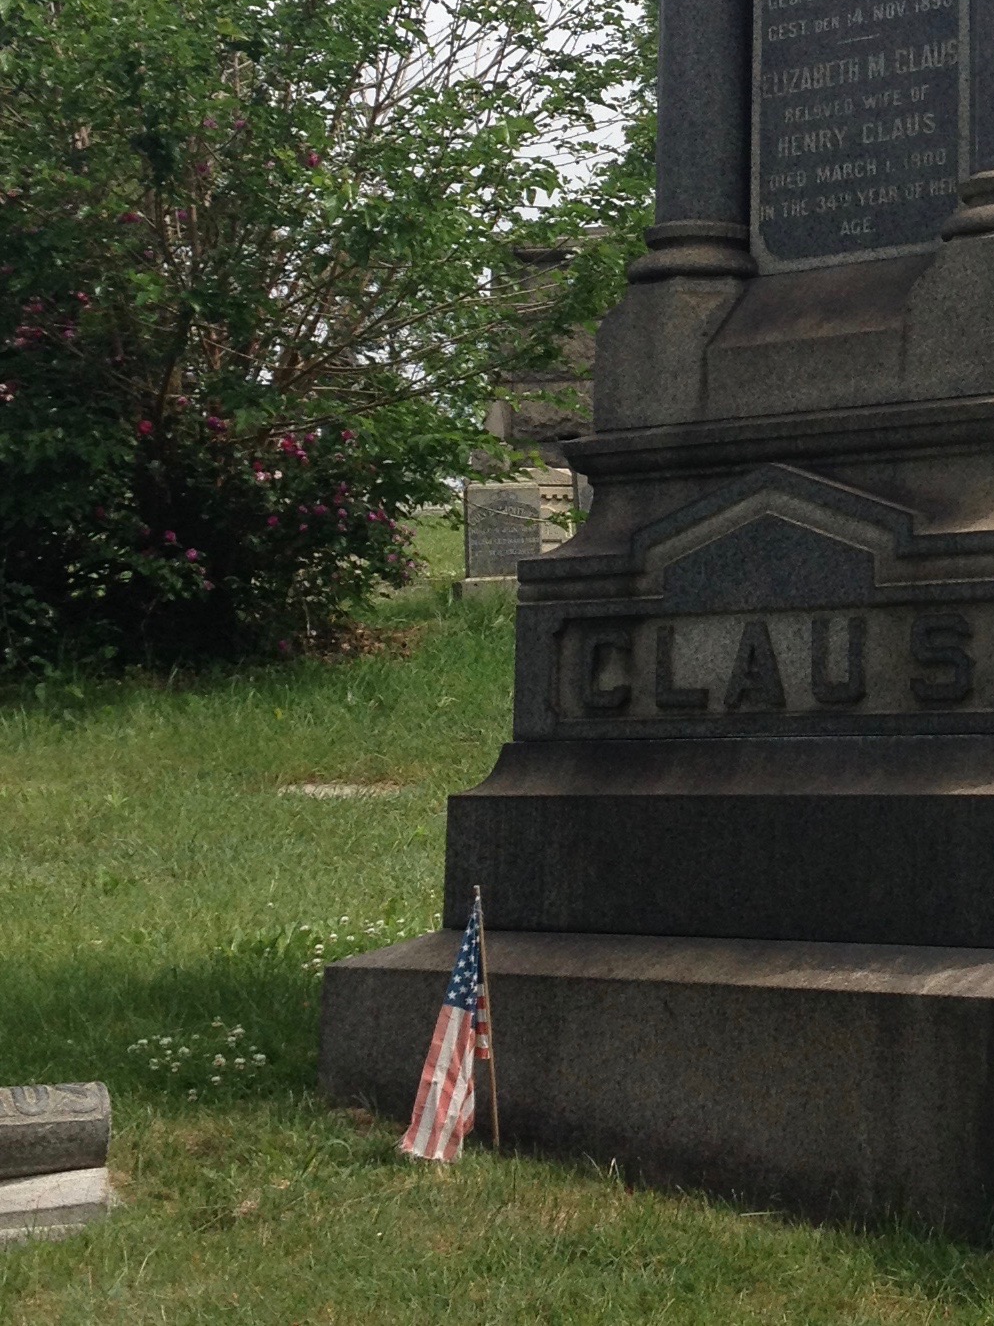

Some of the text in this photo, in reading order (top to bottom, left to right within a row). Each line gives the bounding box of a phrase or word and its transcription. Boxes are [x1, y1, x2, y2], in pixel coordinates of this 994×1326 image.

[814, 16, 840, 33] DEN
[762, 57, 860, 98] ELIZABETH
[895, 34, 958, 74] CLAUS
[784, 85, 930, 123] BELOVED WIFE OF
[778, 113, 936, 157] HENRY CLAUS
[770, 169, 807, 191] DIED
[816, 158, 877, 184] MARCH
[782, 198, 809, 217] THE
[858, 185, 898, 206] YEAR
[904, 182, 924, 199] OF
[930, 177, 957, 196] HER
[580, 612, 978, 712] CLAUS
